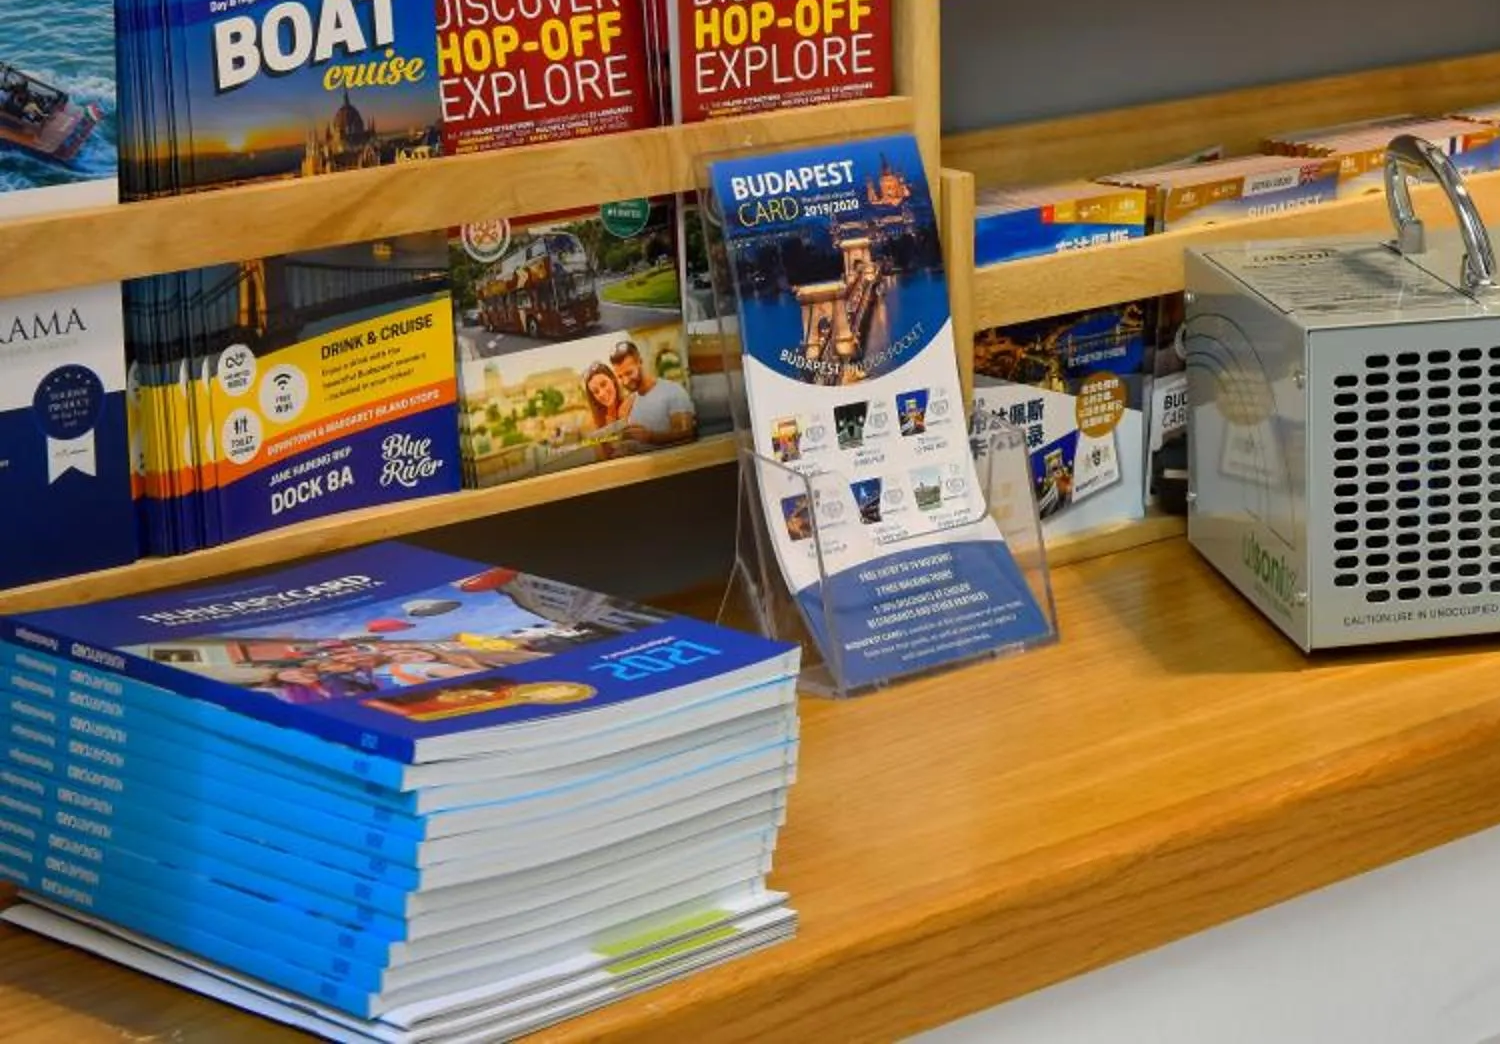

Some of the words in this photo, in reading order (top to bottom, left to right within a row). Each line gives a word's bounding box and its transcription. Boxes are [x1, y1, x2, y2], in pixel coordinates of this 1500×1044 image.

[209, 0, 228, 13] Day
[437, 10, 622, 77] HOP-OFF
[695, 32, 876, 95] EXPLORE
[322, 47, 425, 92] cruise
[438, 54, 633, 124] EXPLORE
[730, 159, 854, 201] BUDAPEST
[737, 196, 799, 228] CARD
[803, 198, 860, 218] 2019/2020
[0, 307, 89, 345] AMA
[320, 335, 364, 361] DRINK
[366, 330, 378, 346] &
[380, 313, 433, 342] CRUISE
[779, 348, 841, 376] BUDAPEST
[325, 409, 374, 434] MARGARET
[375, 397, 408, 417] ISLAND
[409, 388, 441, 407] STOPS
[381, 432, 433, 461] Blue
[270, 474, 323, 516] DOCK
[326, 465, 355, 493] 8A
[379, 457, 444, 488] River
[1417, 612, 1427, 620] IN
[1429, 604, 1499, 620] UNOCCUPIED
